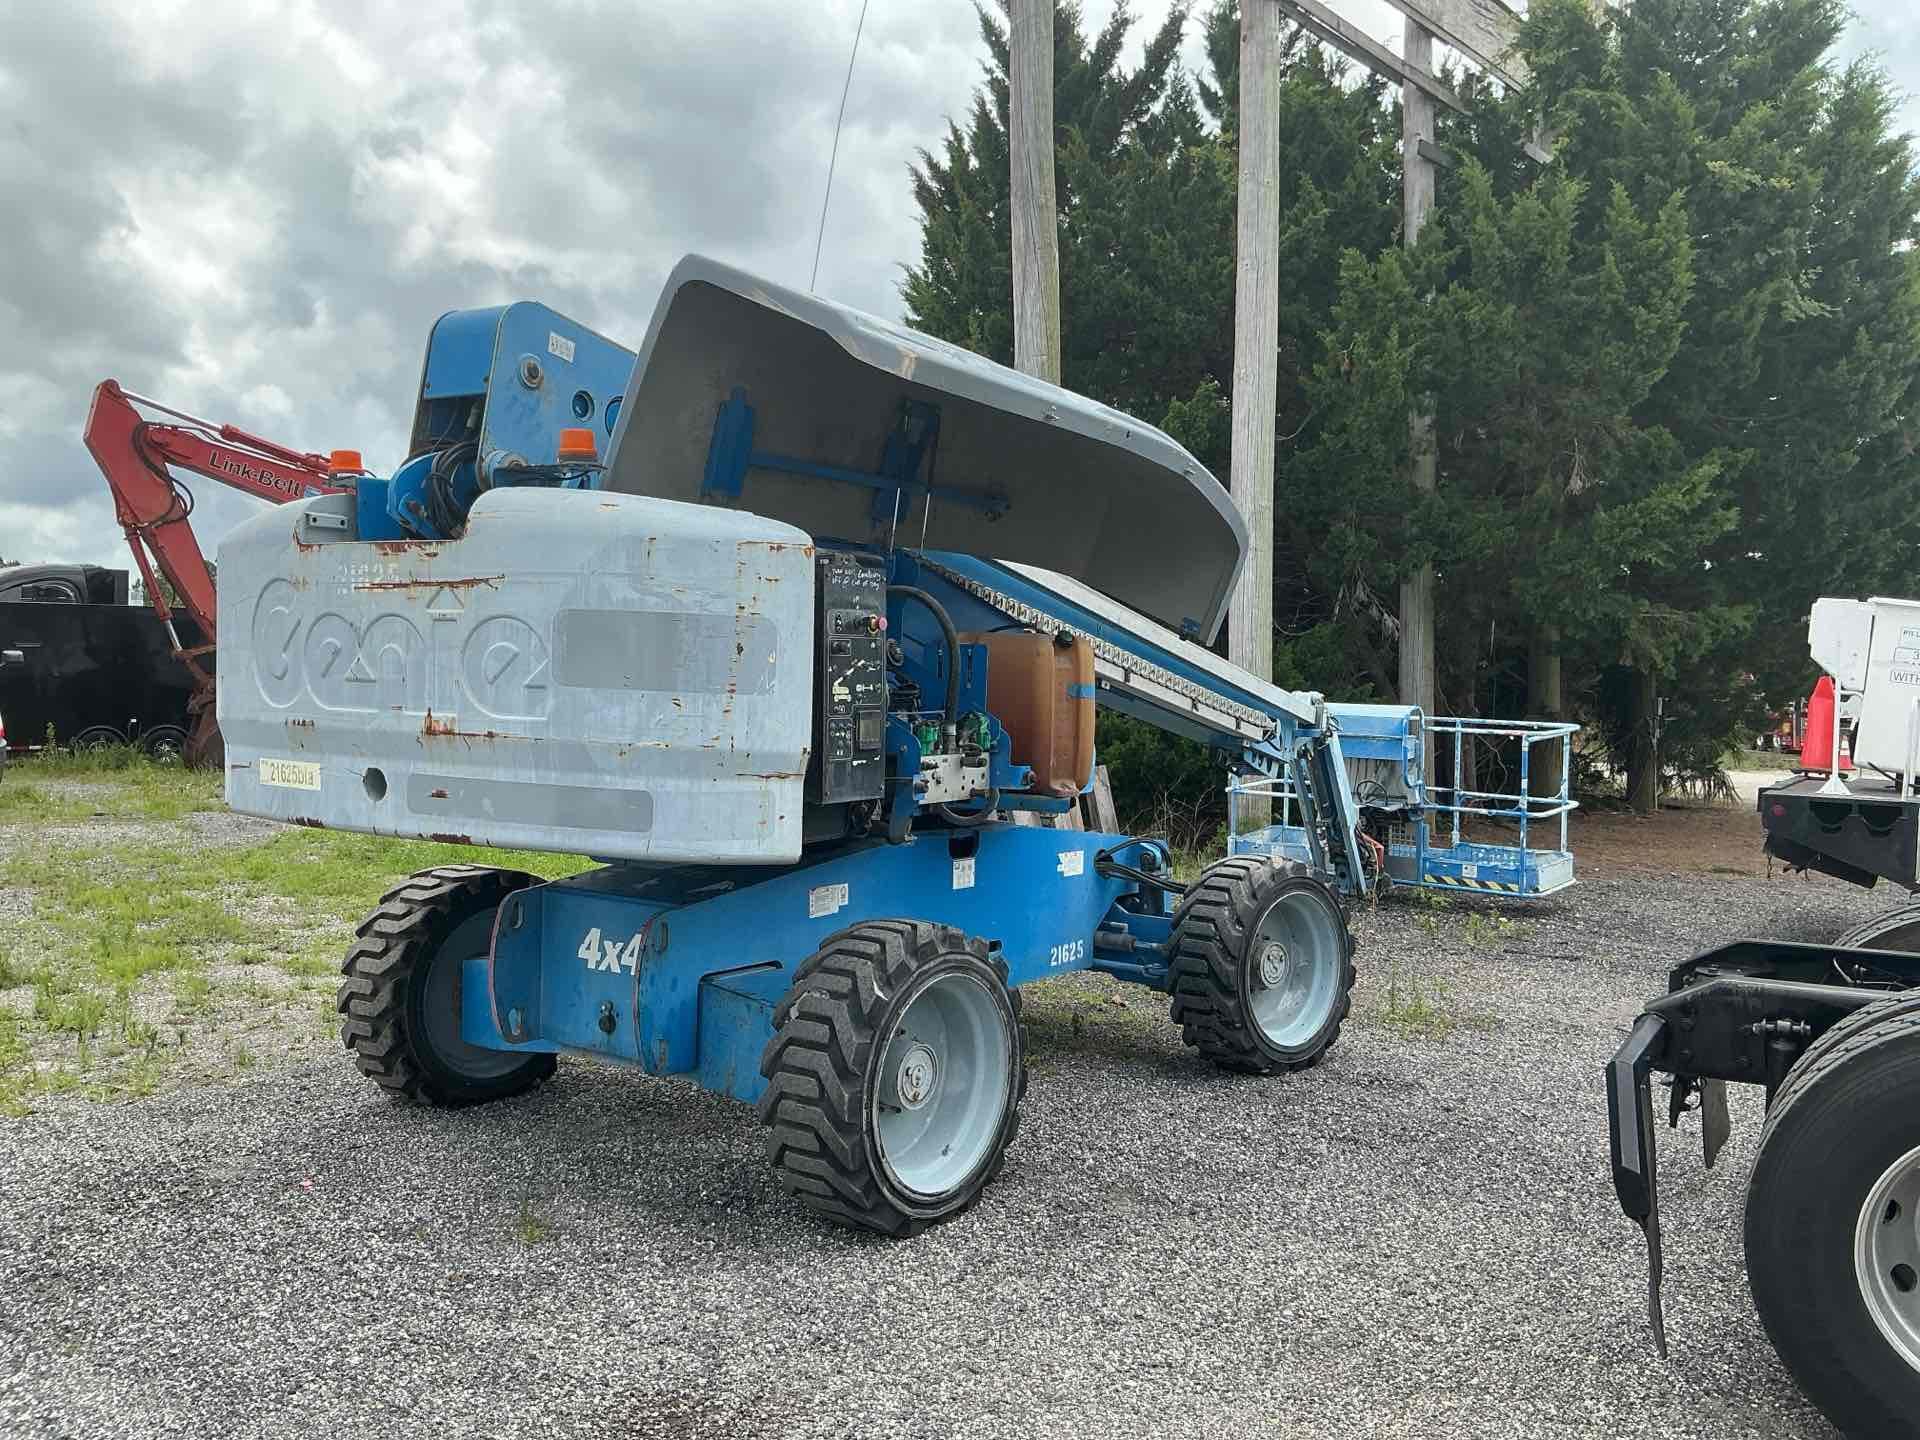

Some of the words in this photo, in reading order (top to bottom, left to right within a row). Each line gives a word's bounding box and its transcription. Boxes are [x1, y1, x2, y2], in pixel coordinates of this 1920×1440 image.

[209, 449, 300, 497] Link-Belt
[251, 577, 551, 720] Genie
[578, 927, 642, 976] 4x4
[1050, 939, 1084, 967] 21625
